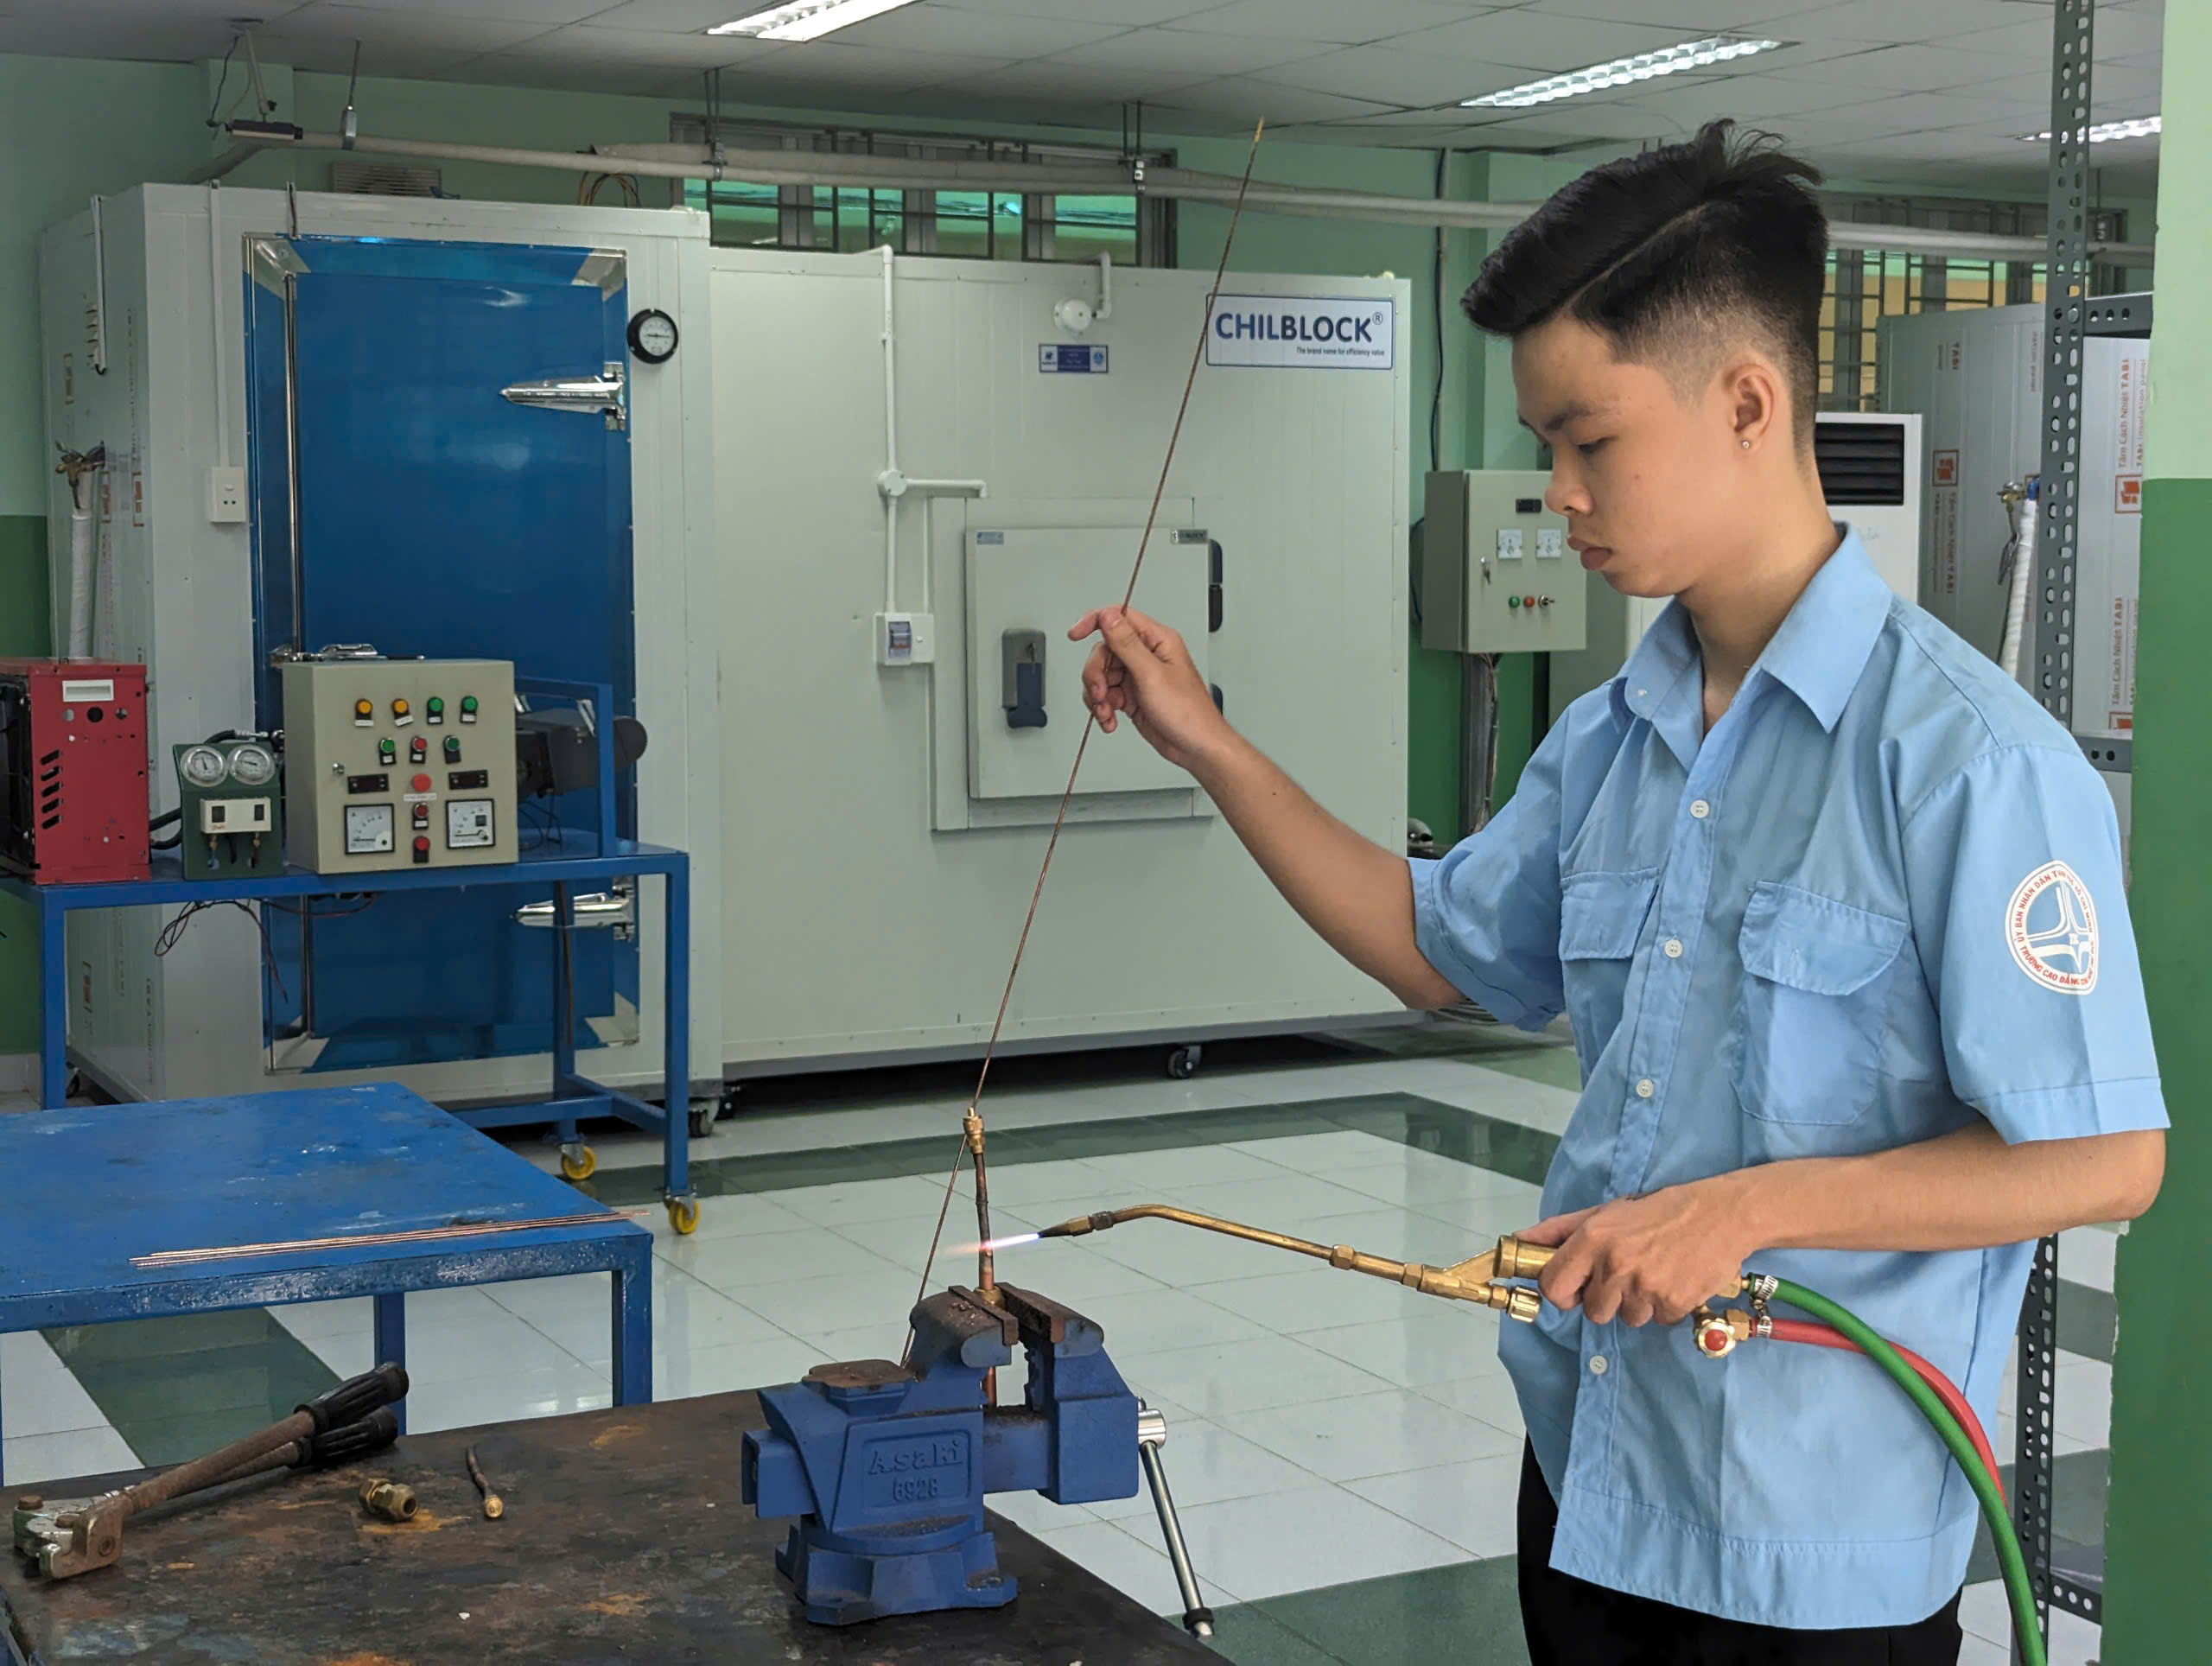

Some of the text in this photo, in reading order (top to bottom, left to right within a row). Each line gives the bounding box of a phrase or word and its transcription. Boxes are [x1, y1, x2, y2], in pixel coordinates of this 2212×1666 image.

[1346, 347, 1370, 357] efficiency
[2015, 911, 2024, 927] BAN
[2043, 969, 2058, 982] CAO
